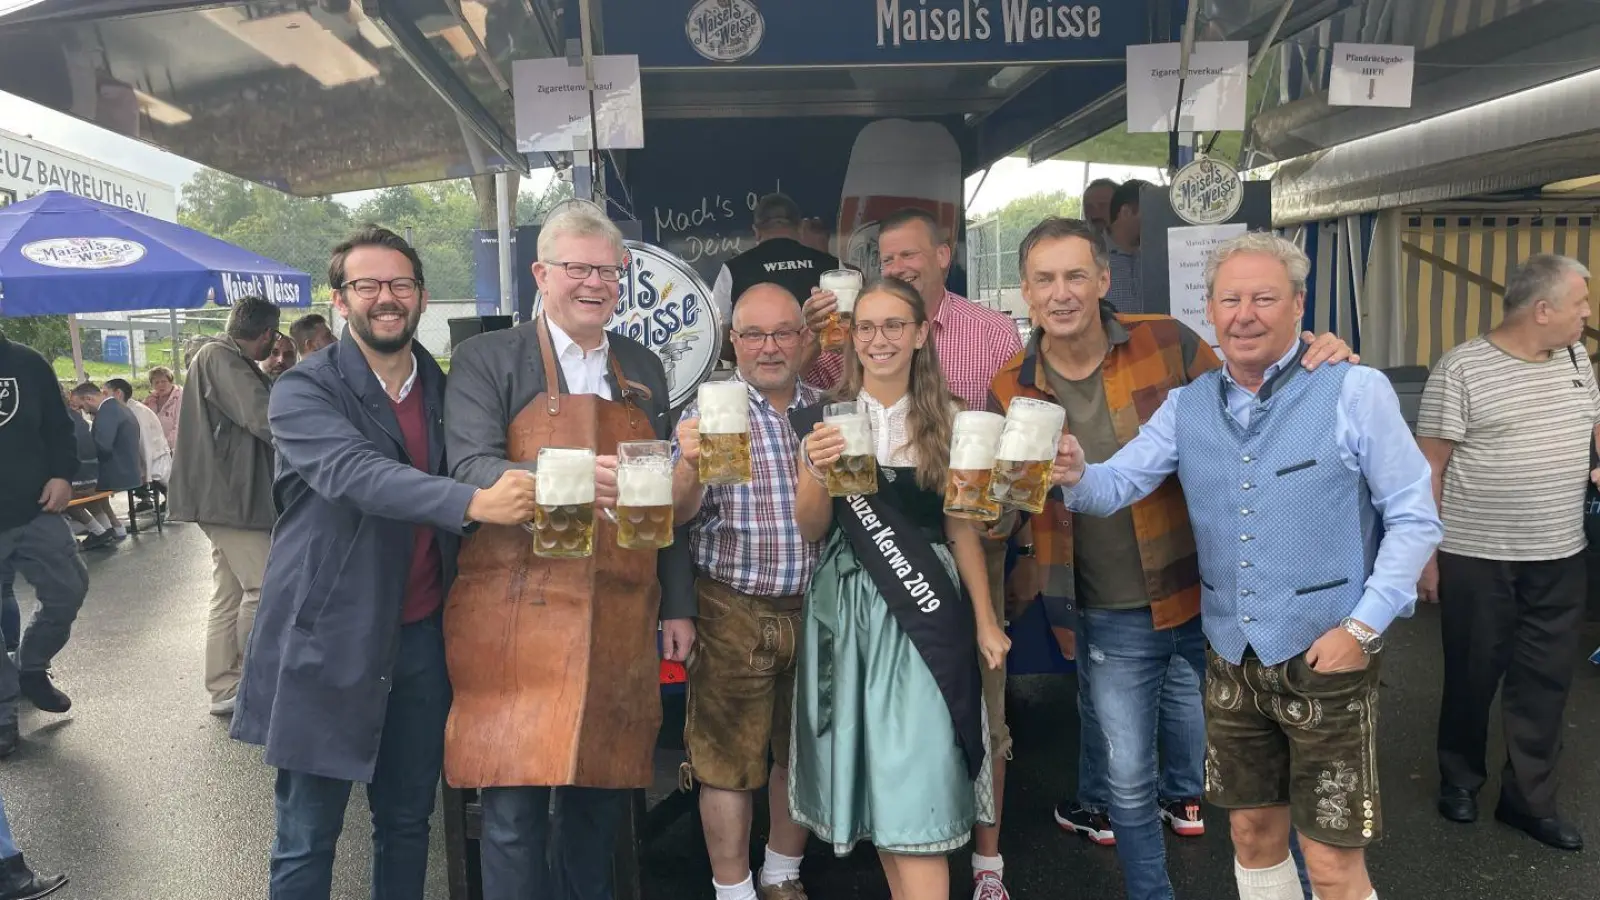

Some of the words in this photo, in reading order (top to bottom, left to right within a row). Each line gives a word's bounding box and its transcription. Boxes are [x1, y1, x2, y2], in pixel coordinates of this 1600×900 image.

[715, 12, 757, 46] Weisse
[876, 0, 992, 47] Maisel's
[1002, 0, 1101, 44] Weisse
[1151, 67, 1224, 78] Zigaretnverkauf
[1361, 67, 1385, 77] HIER
[537, 82, 613, 94] Zigarettenvkauf
[37, 159, 123, 206] BAYREUTH
[763, 260, 814, 272] WERNI
[263, 274, 300, 303] Weisse
[871, 526, 912, 579] Kerwa
[903, 572, 941, 613] 2019
